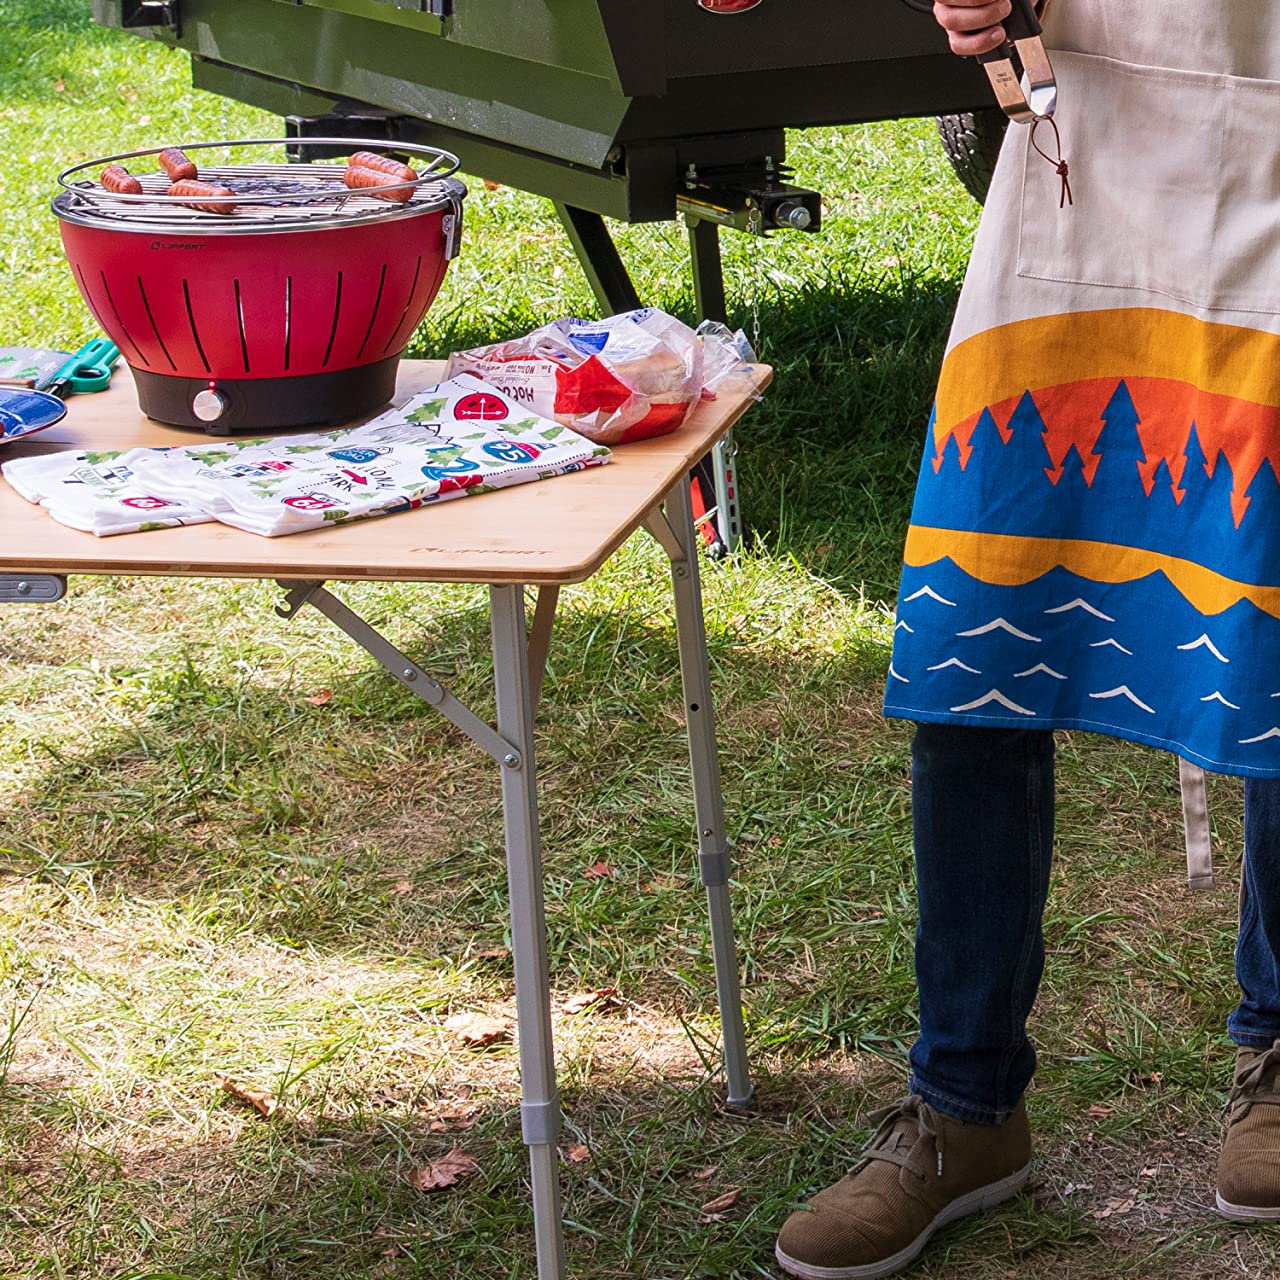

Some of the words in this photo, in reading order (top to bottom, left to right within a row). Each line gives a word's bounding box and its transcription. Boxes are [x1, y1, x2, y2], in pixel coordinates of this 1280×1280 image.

[512, 387, 535, 403] Hot
[489, 443, 526, 462] 95
[320, 472, 358, 493] PARK
